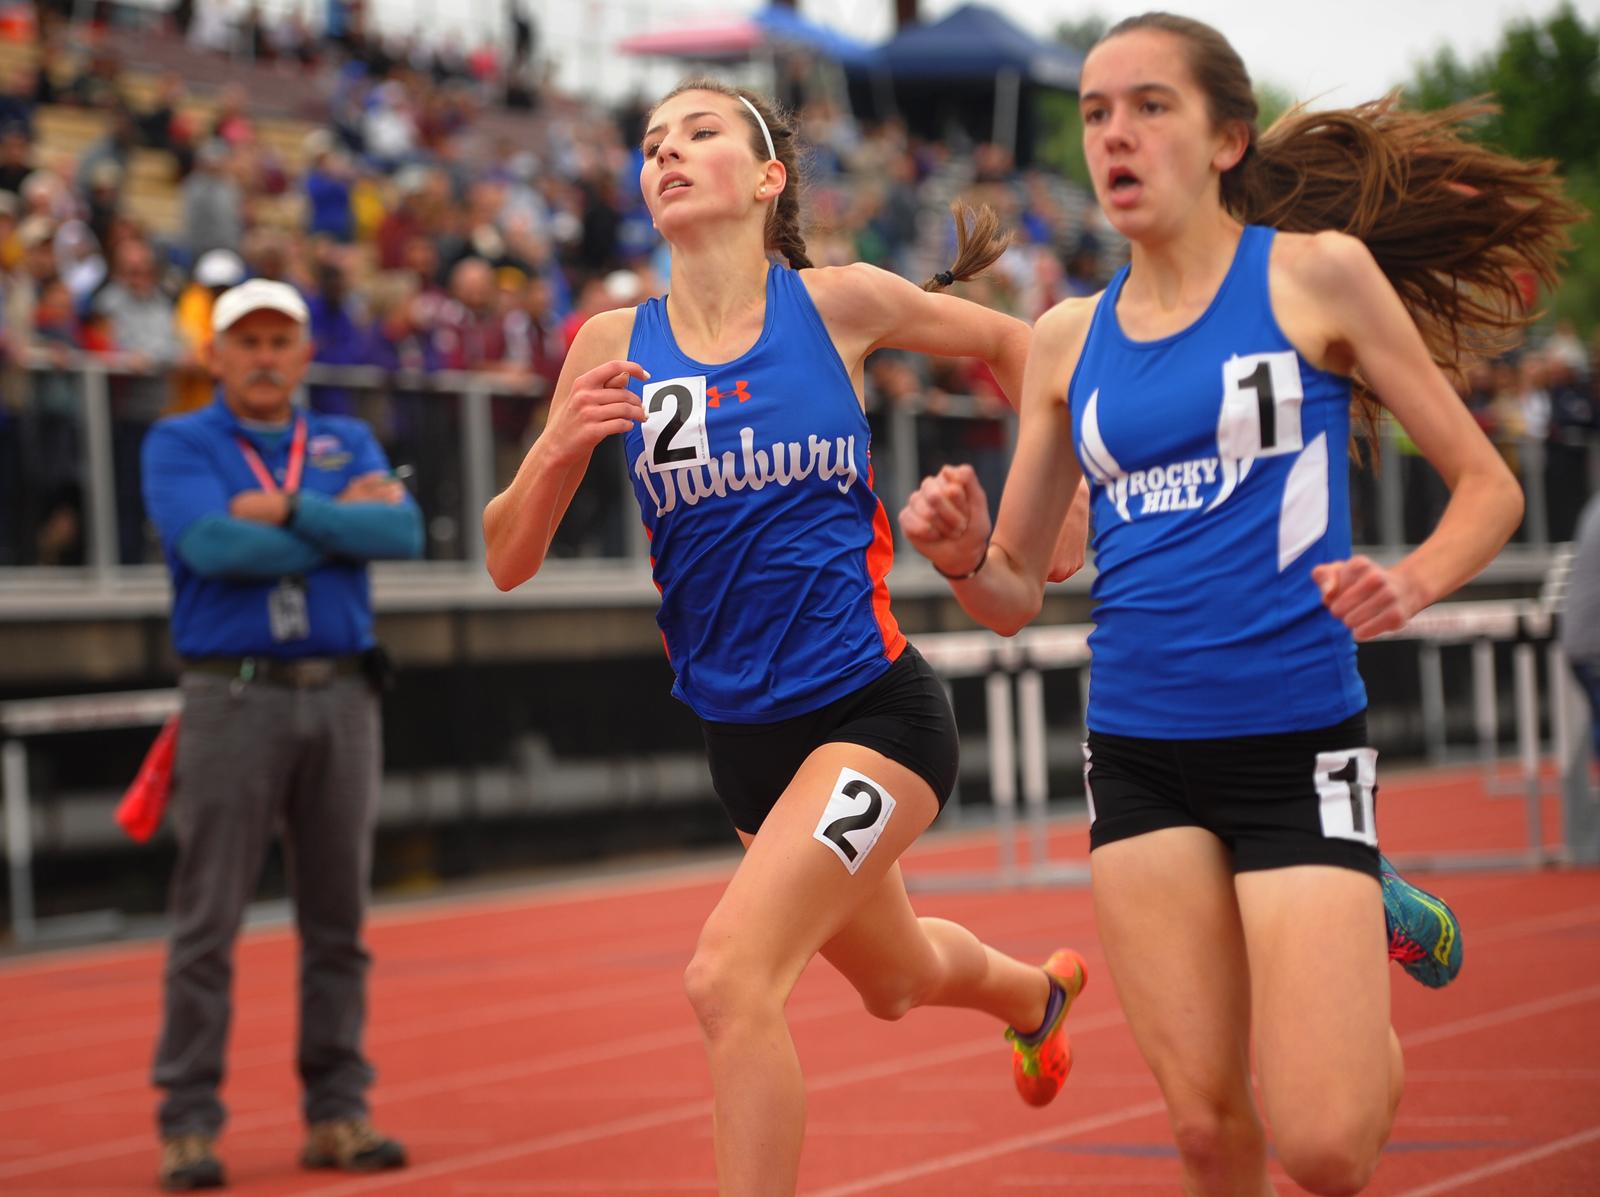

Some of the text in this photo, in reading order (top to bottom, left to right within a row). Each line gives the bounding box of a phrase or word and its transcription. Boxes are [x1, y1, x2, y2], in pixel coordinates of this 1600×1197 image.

[648, 384, 697, 466] 2
[1238, 361, 1277, 450] 1
[1129, 457, 1219, 497] ROCKY
[1139, 483, 1204, 515] HILL
[822, 780, 882, 863] 2
[1328, 756, 1365, 833] 1
